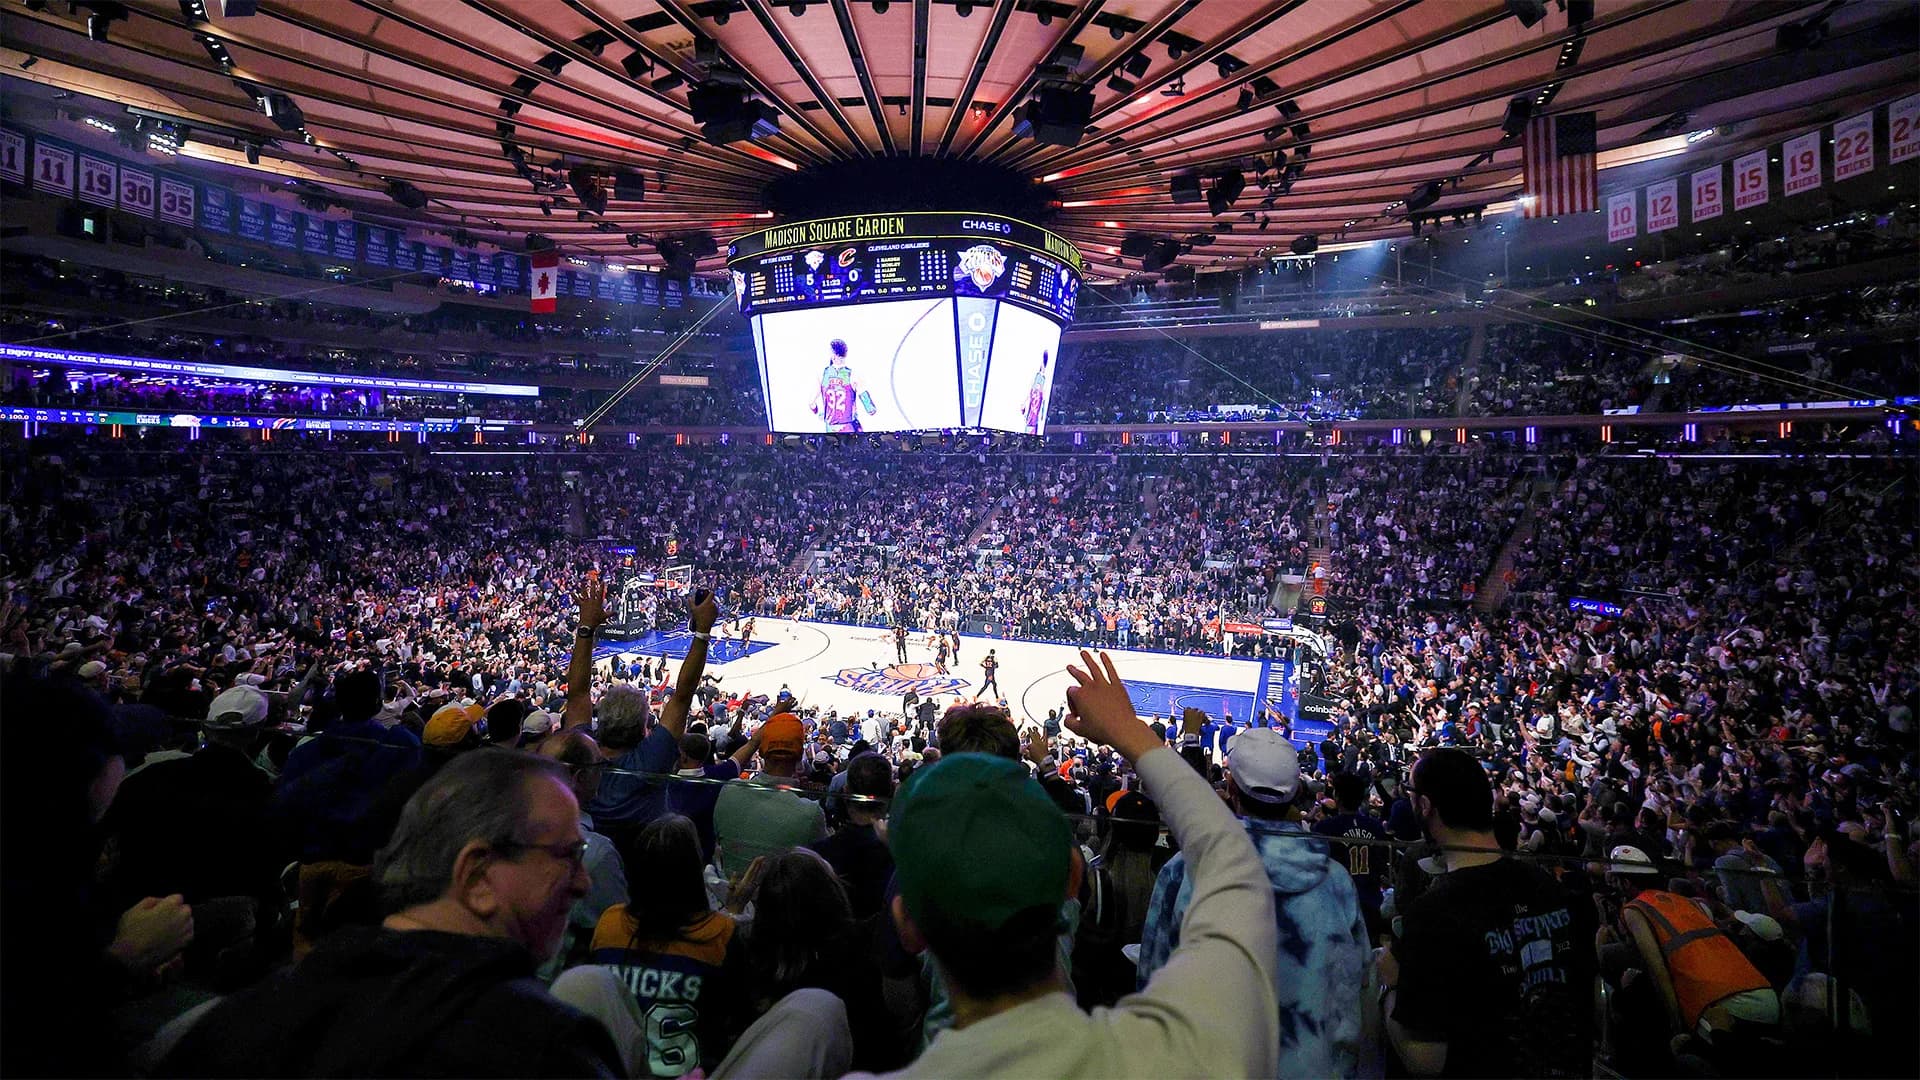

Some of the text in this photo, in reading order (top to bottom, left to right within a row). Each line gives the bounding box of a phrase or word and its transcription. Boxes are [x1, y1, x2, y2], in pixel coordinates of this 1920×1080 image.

[1837, 131, 1869, 161] 22
[1892, 141, 1920, 159] KNIC
[41, 158, 66, 186] 11
[1790, 150, 1814, 177] 19
[1837, 157, 1871, 176] KNICKS
[85, 169, 112, 195] 19
[1739, 167, 1761, 192] 15
[1786, 175, 1819, 192] KNICKS
[123, 181, 150, 206] 30
[1697, 182, 1716, 205] 15
[1736, 191, 1766, 206] KNICKS
[163, 192, 192, 216] 35
[1652, 196, 1672, 216] 12
[1694, 204, 1721, 218] KNICKS
[962, 220, 1001, 232] CHASE
[1613, 206, 1631, 226] 10
[1648, 216, 1676, 229] KNICKS
[765, 217, 904, 249] MADISON SQUARE GARDEN
[1611, 225, 1635, 238] KNICKS
[868, 244, 900, 252] CLEVELAND
[1045, 231, 1069, 260] MADISON
[806, 273, 814, 285] 5
[849, 270, 858, 282] 0
[6, 348, 33, 357] ENJOY
[34, 351, 66, 360] SPECIAL
[68, 354, 98, 363] ACCESS,
[968, 335, 984, 408] CHASE
[827, 390, 845, 410] 32
[1304, 705, 1334, 714] coinba
[1349, 845, 1370, 875] 11
[1484, 928, 1513, 954] Big
[608, 964, 701, 1001] NICKS
[643, 1003, 700, 1078] 6
